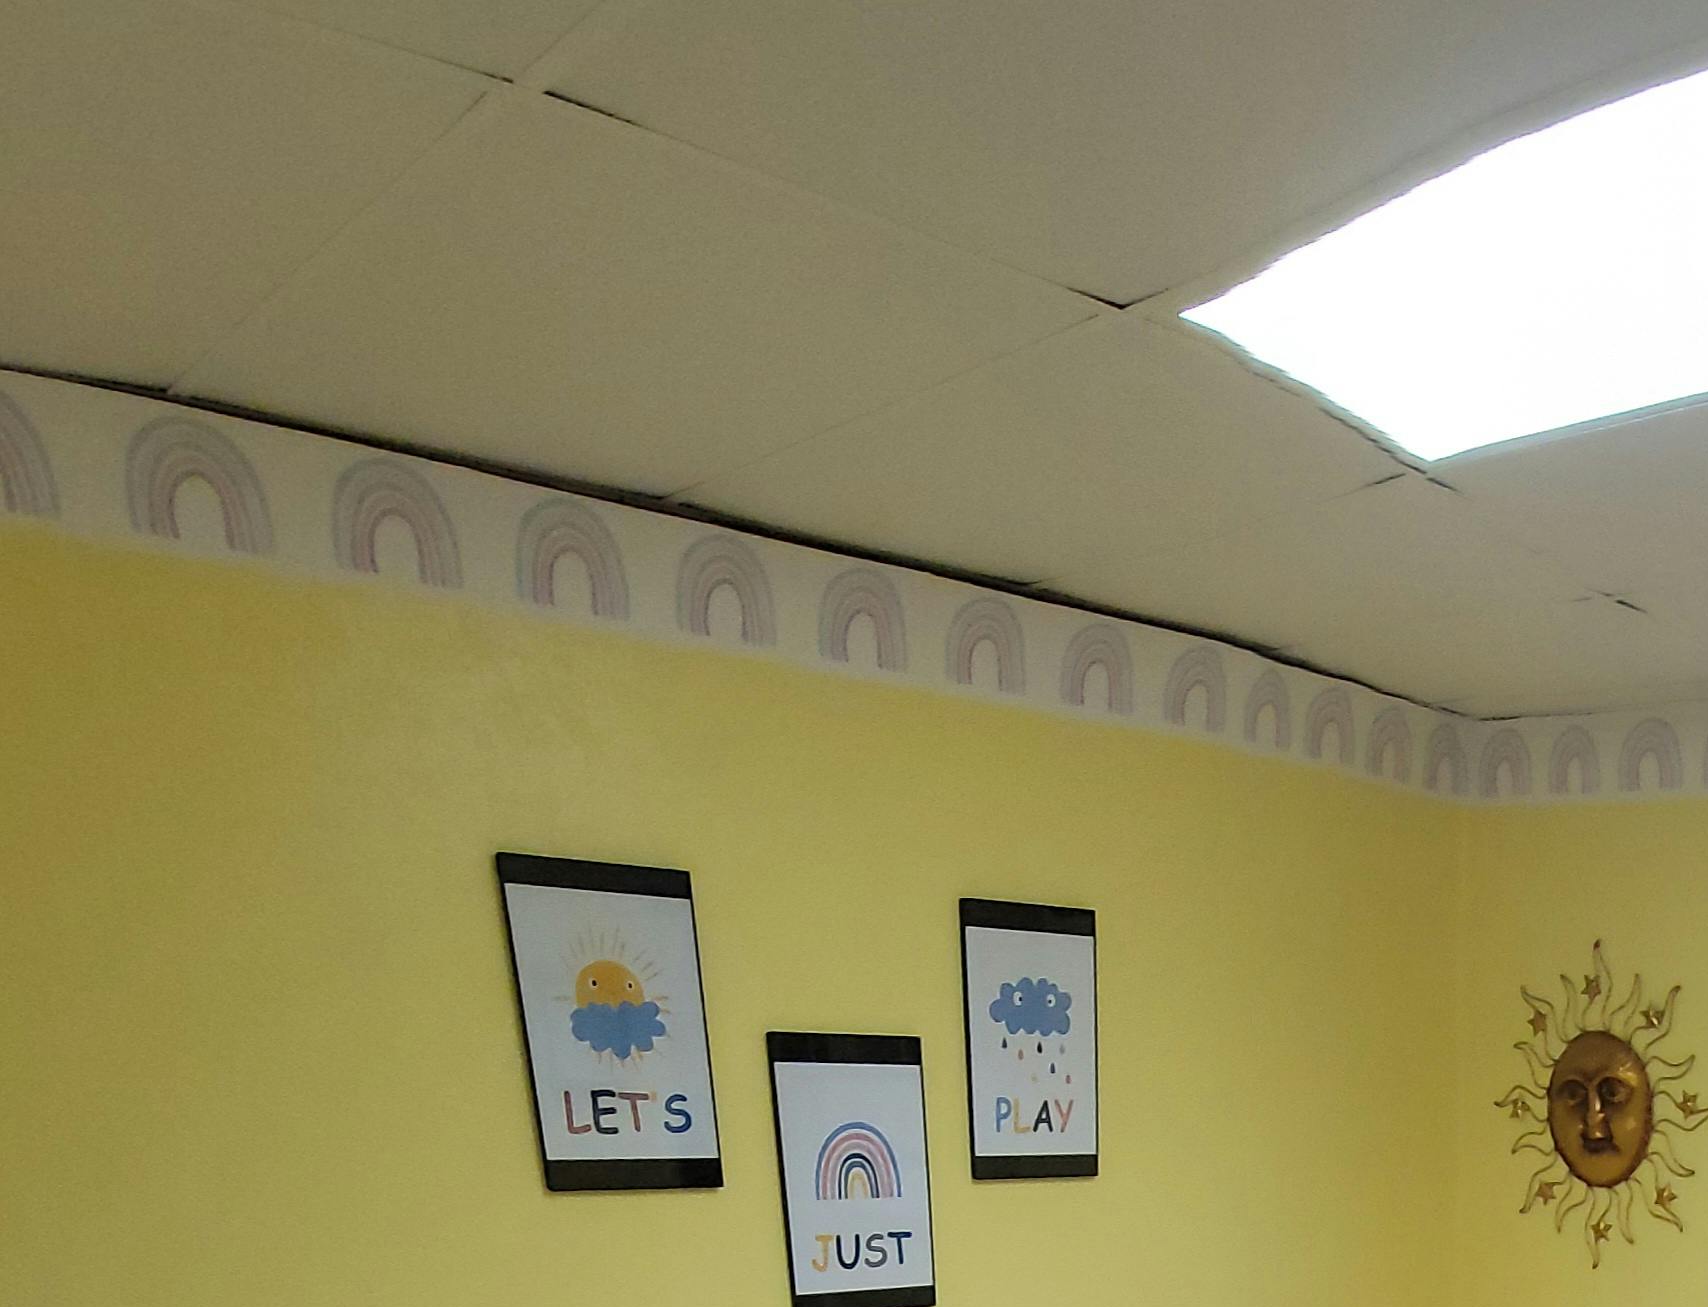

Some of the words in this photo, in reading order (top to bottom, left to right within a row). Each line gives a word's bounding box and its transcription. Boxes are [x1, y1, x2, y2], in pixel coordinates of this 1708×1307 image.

[563, 1090, 692, 1135] LET'S
[995, 1096, 1074, 1133] PLAY
[811, 1230, 912, 1272] JUST
